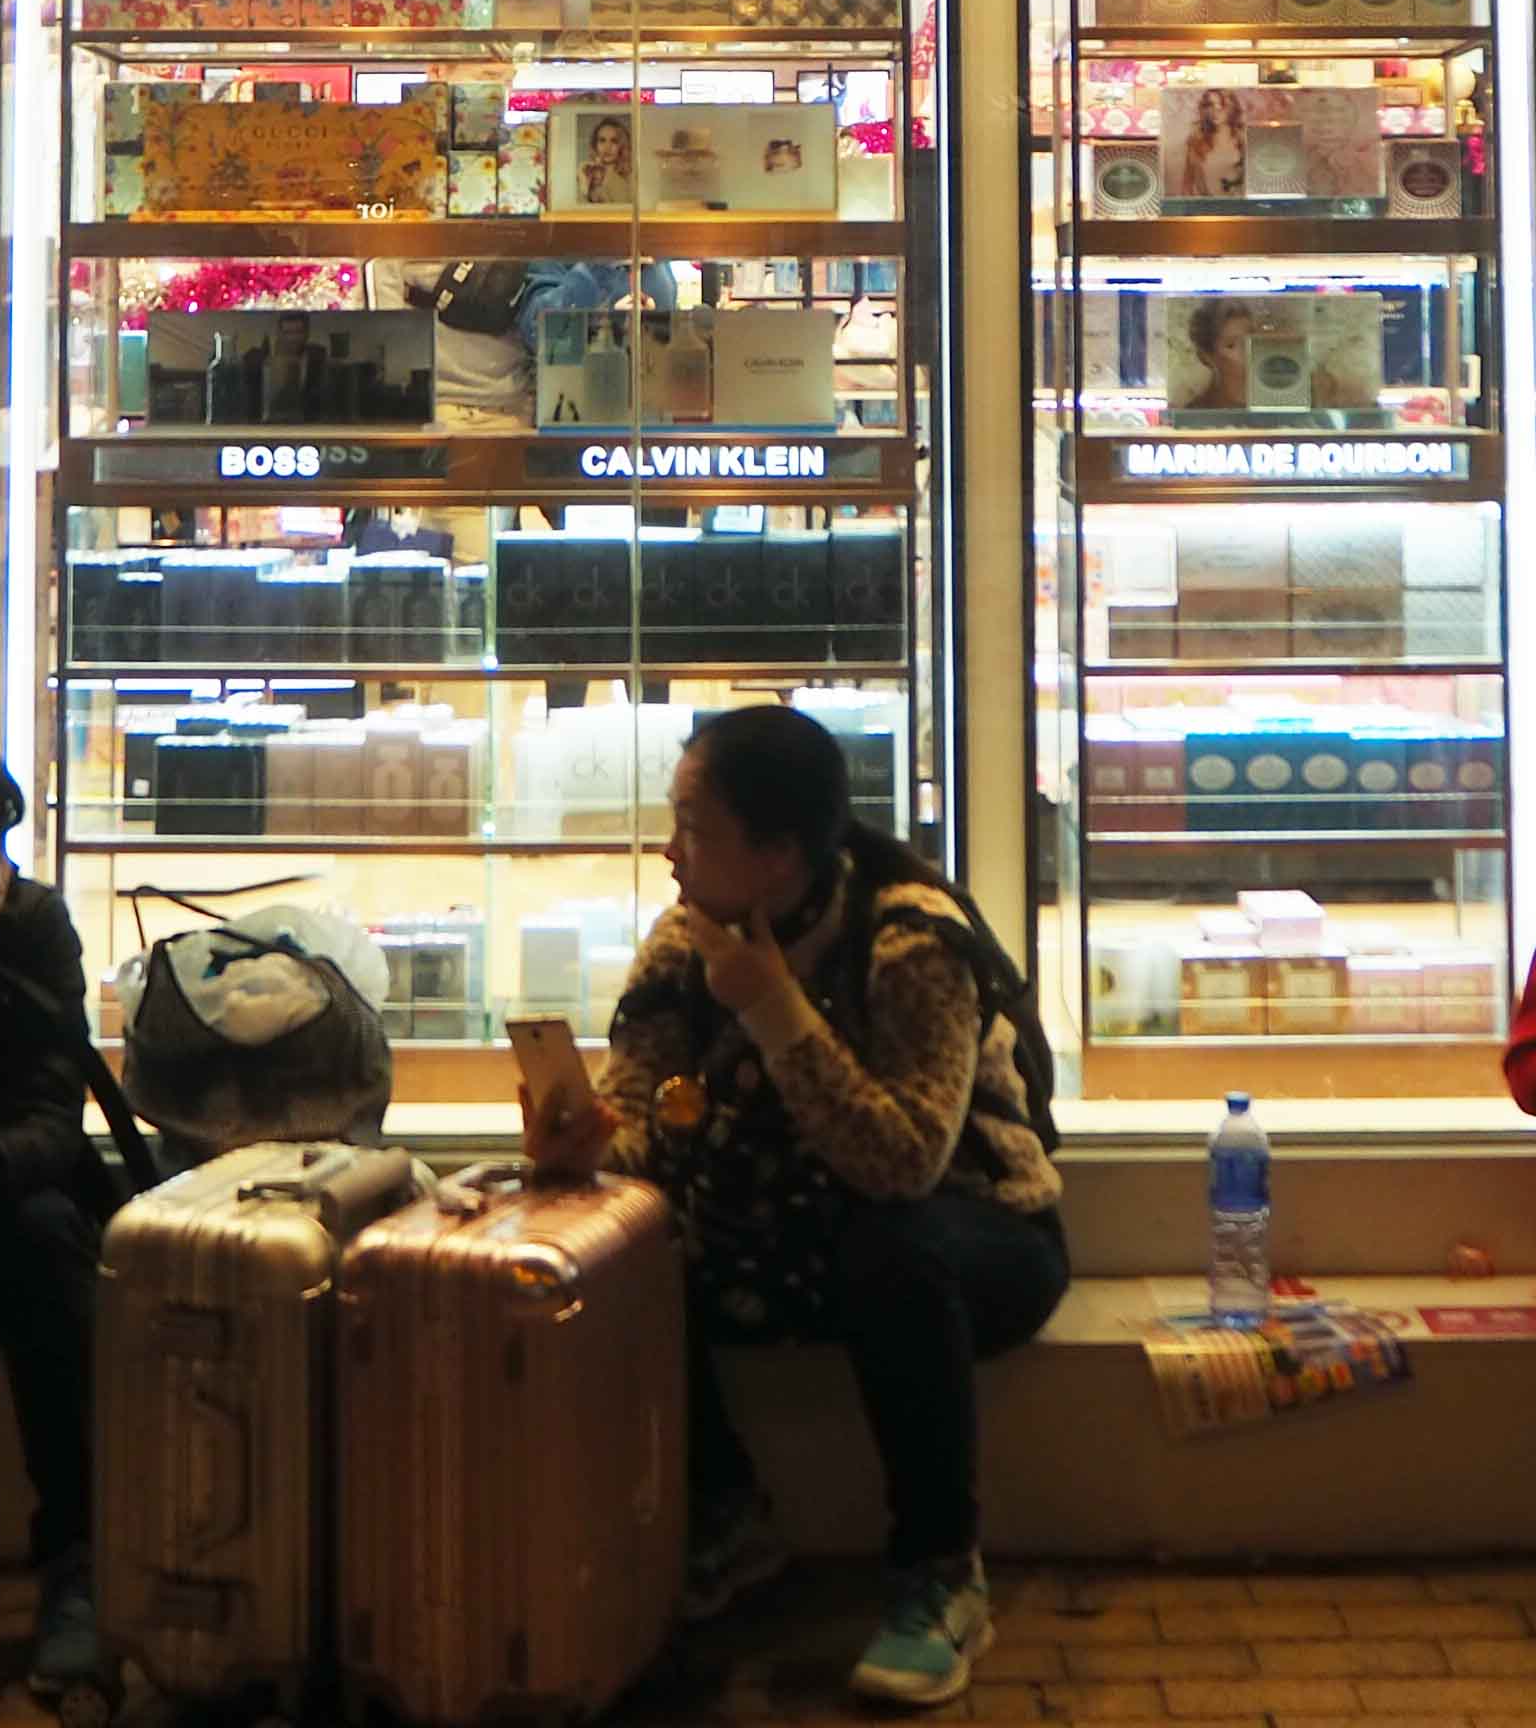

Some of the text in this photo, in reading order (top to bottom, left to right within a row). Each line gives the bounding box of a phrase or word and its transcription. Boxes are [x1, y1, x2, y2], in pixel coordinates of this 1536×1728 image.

[221, 446, 321, 477] BOSS
[581, 445, 825, 477] CALVIN KLEIN
[1128, 443, 1452, 474] MARINA DE BOURBON
